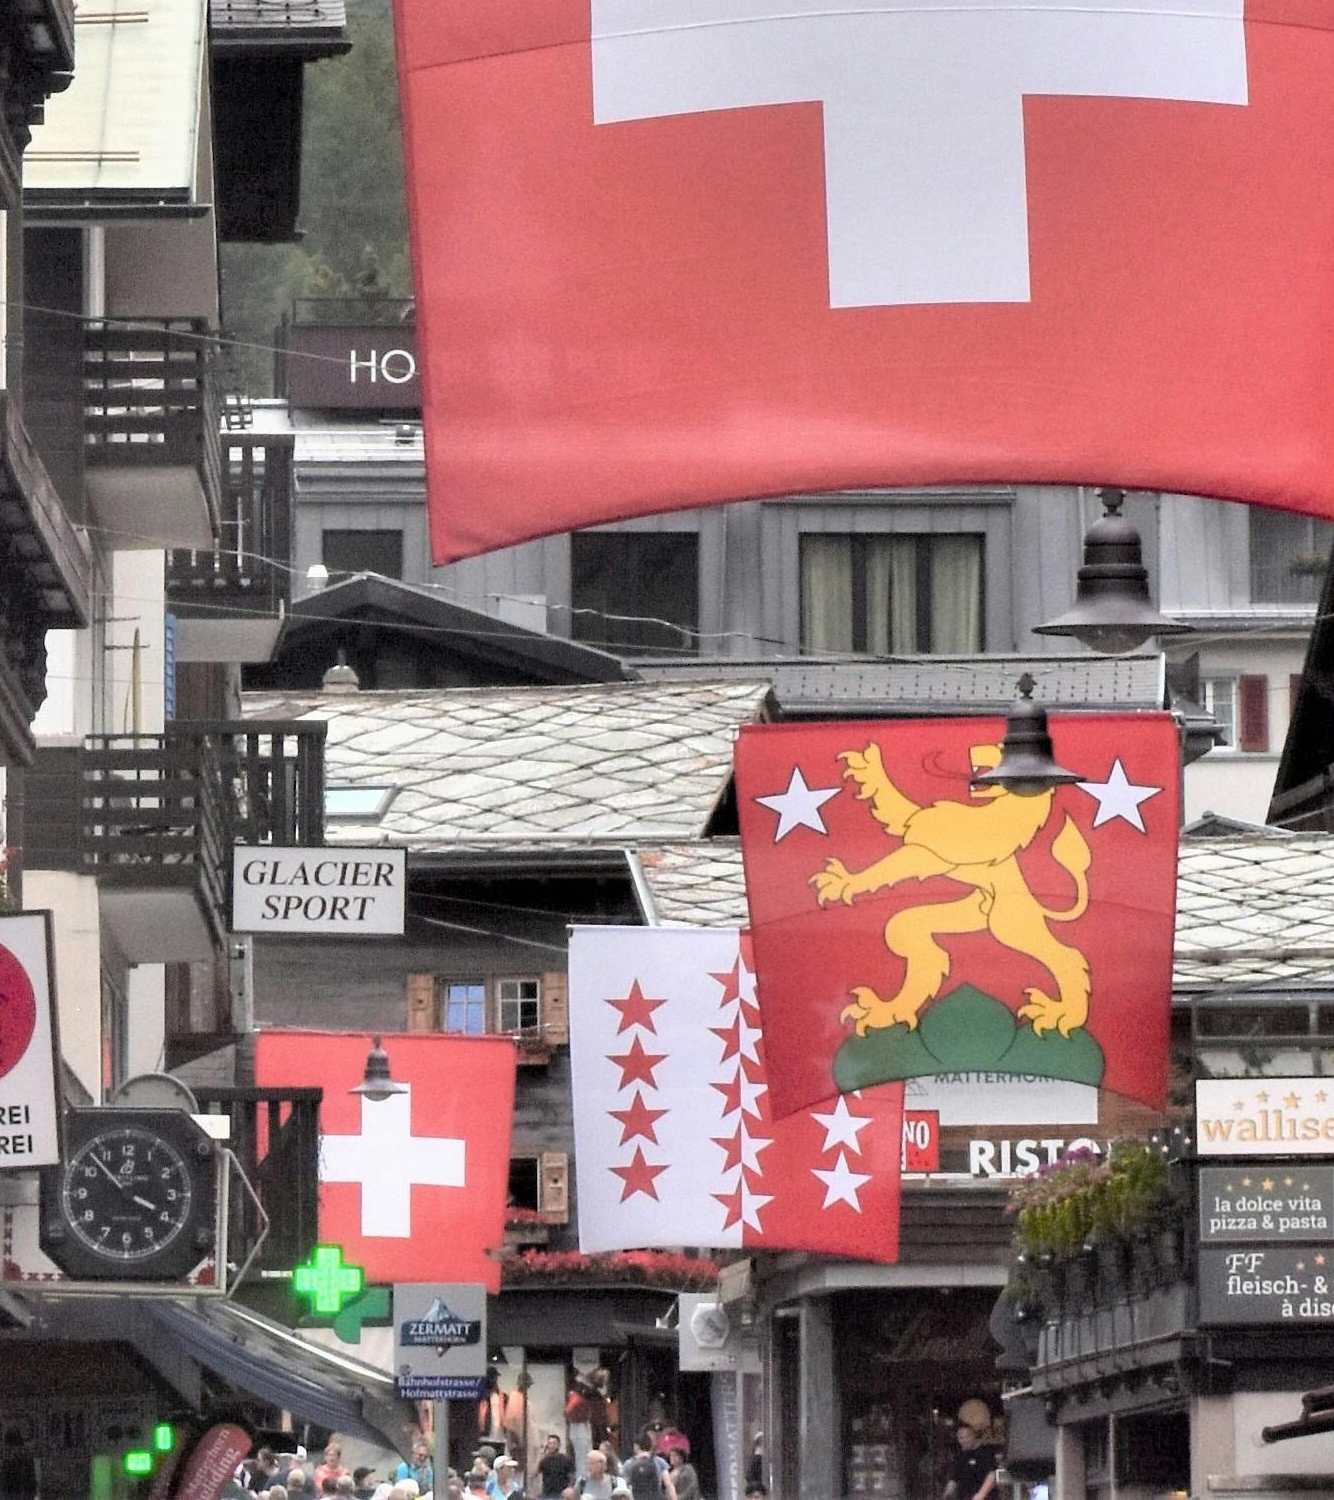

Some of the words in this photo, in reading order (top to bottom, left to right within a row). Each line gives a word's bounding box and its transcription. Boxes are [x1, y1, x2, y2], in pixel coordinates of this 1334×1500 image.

[243, 859, 394, 887] GLACIER
[261, 894, 376, 921] SPORT
[122, 1145, 134, 1156] 12
[1215, 1196, 1230, 1213] la
[1236, 1196, 1283, 1212] dolce
[1288, 1195, 1322, 1212] vita
[1210, 1214, 1257, 1233] pizza
[1262, 1215, 1274, 1229] &
[1279, 1214, 1327, 1233] pasta
[1226, 1275, 1308, 1296] fleisch-
[1313, 1275, 1328, 1295] &
[1281, 1299, 1294, 1317] à
[409, 1323, 471, 1335] ZERMATT
